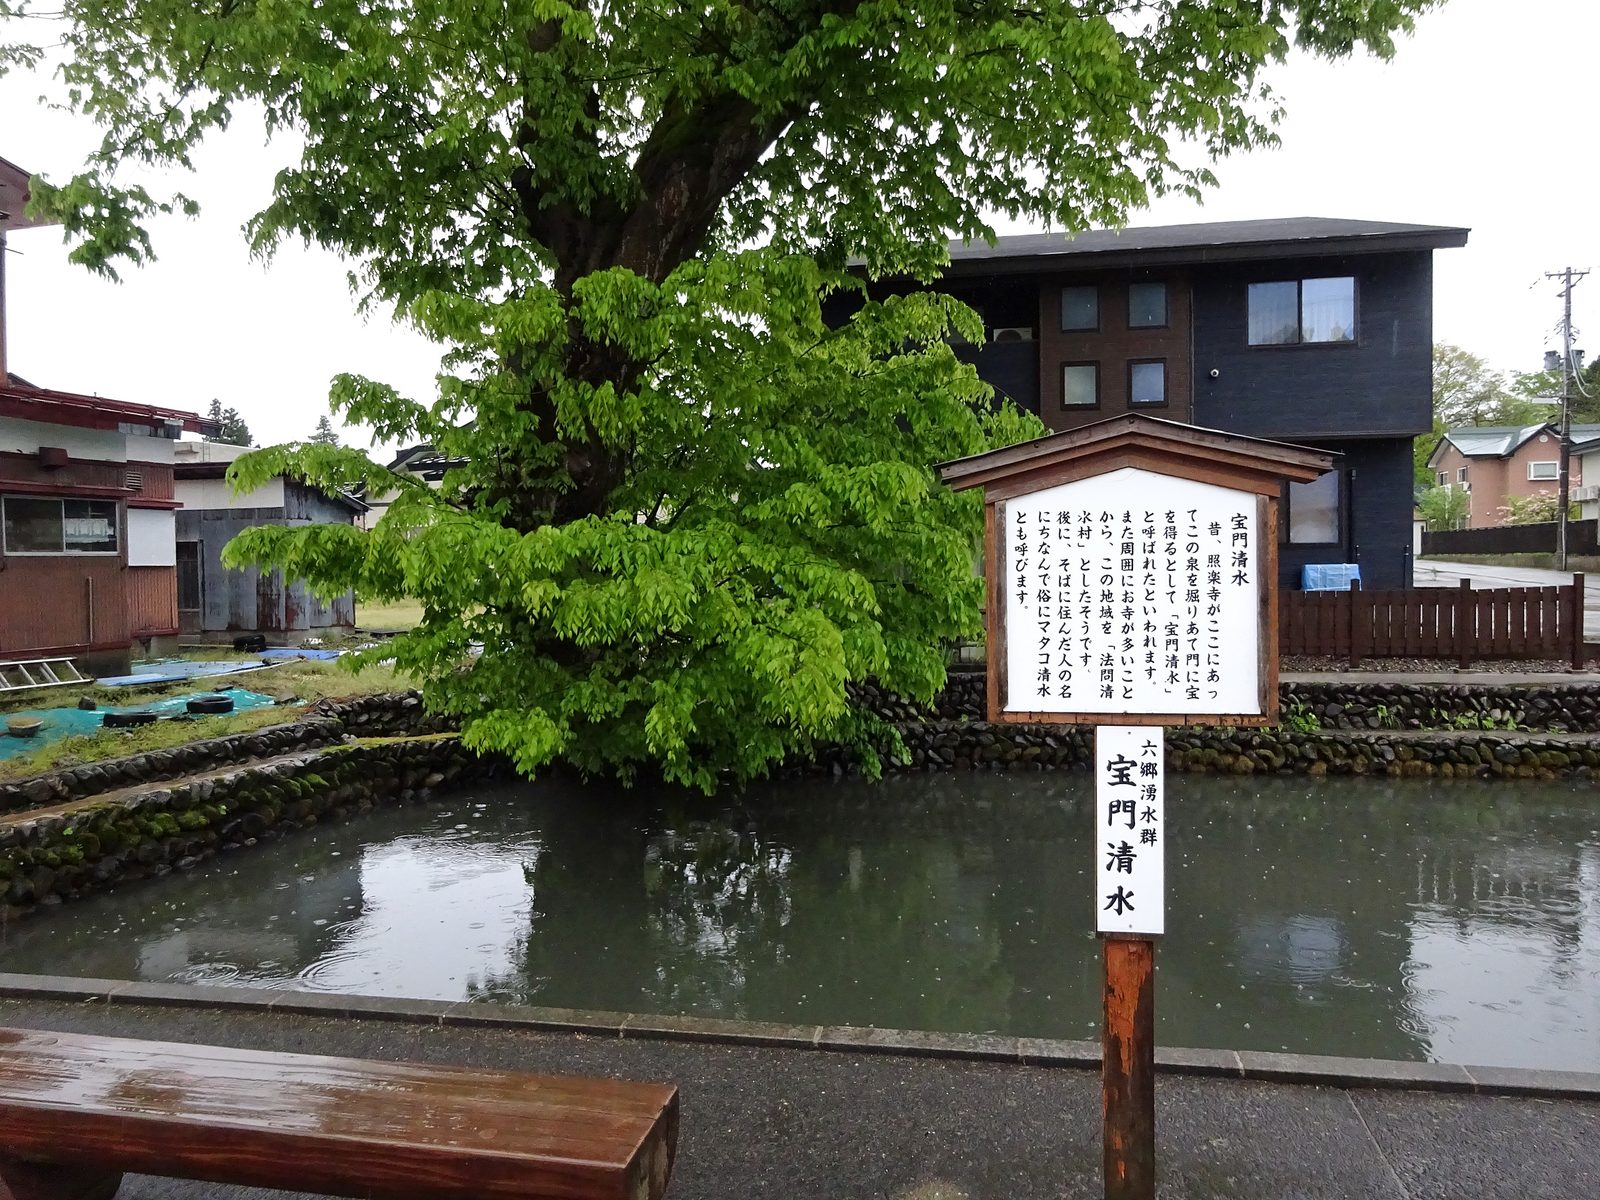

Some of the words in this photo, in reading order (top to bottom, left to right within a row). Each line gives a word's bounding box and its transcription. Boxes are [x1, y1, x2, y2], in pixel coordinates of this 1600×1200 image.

[1014, 511, 1029, 610] とも呼びます。
[1036, 511, 1052, 698] にちなんで俗にマタコ清水
[1056, 511, 1073, 699] 後に、そばに住んだ人の名
[1098, 510, 1115, 700] から、この地域を「法問清
[1119, 509, 1135, 700] また周囲にお寺が多いこと
[1142, 511, 1158, 685] と呼ばれたといわれます。
[1206, 521, 1222, 700] 昔、照楽寺がここにあっ
[1230, 512, 1250, 587] 宝門清水
[1104, 753, 1137, 917] 宝門清水
[1140, 739, 1157, 847] 六郷湧水群
